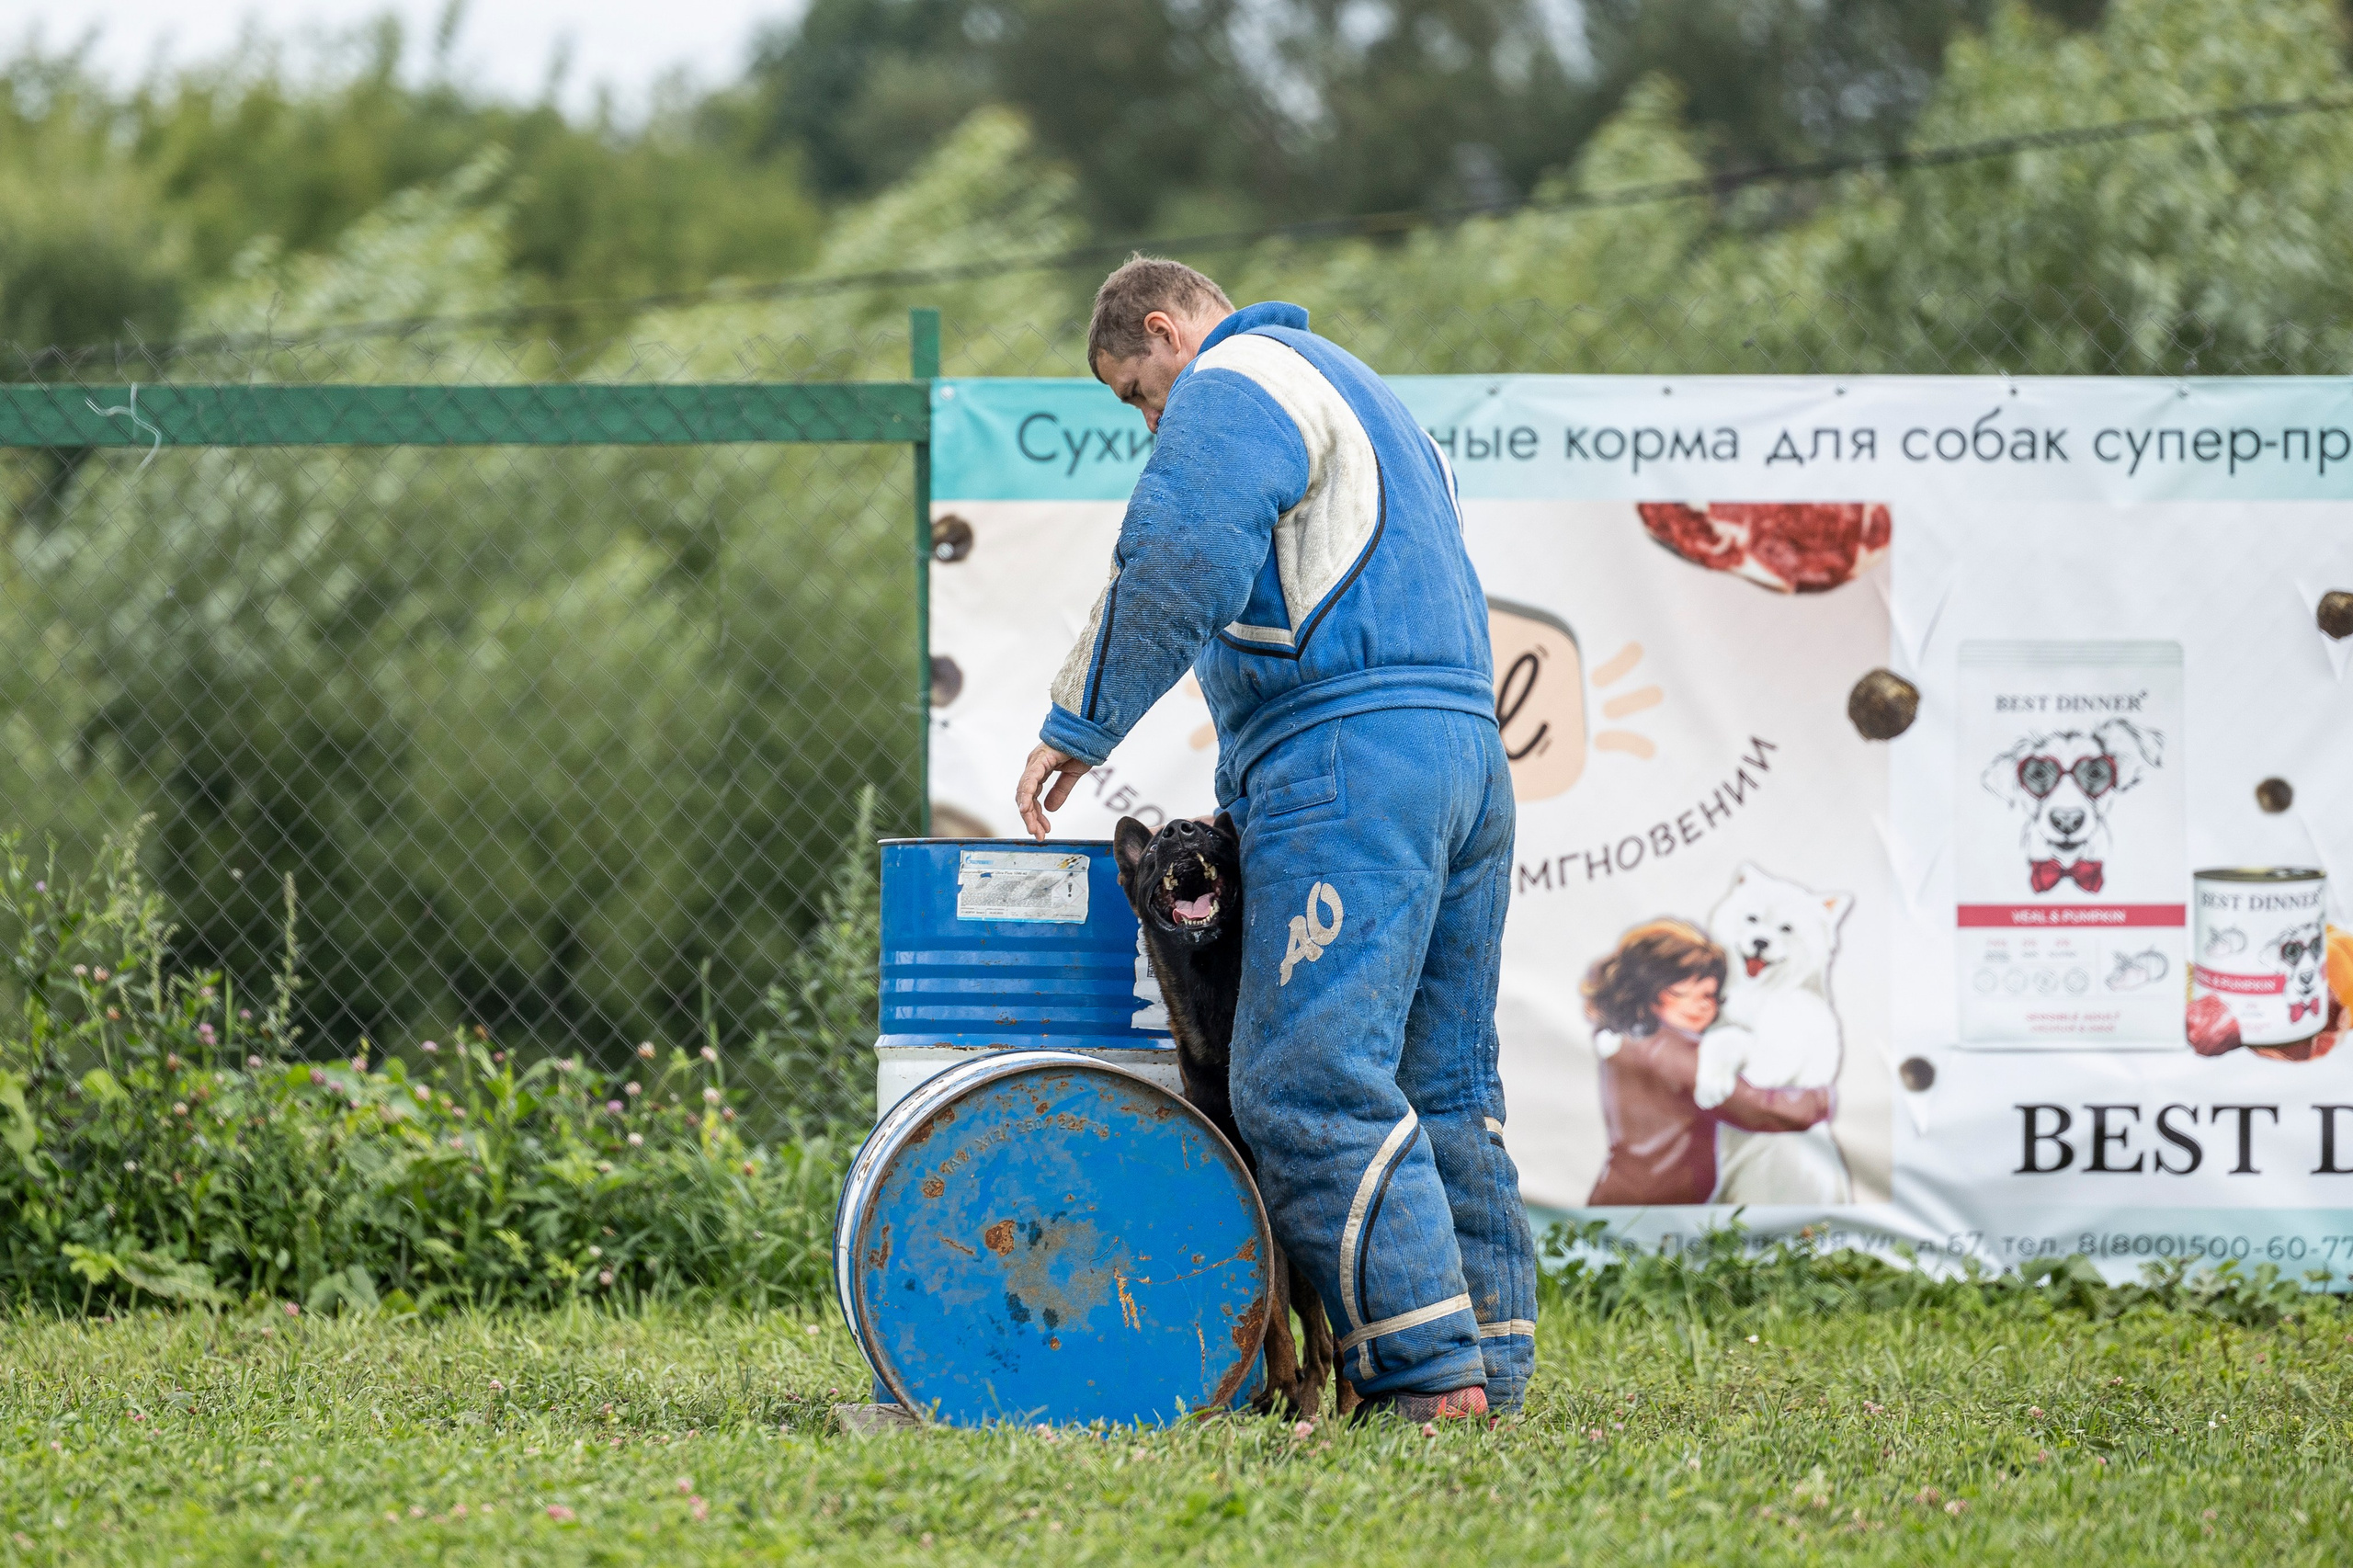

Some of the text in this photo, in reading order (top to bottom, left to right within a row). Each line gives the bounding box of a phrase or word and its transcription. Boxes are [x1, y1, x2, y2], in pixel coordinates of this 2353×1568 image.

[1017, 406, 2351, 477] Сухи ные корма для собак супер-пр
[1995, 694, 2143, 712] BEST DINNER
[1518, 735, 1779, 893] МГНОВЕНИИ
[2012, 1105, 2279, 1176] BEST
